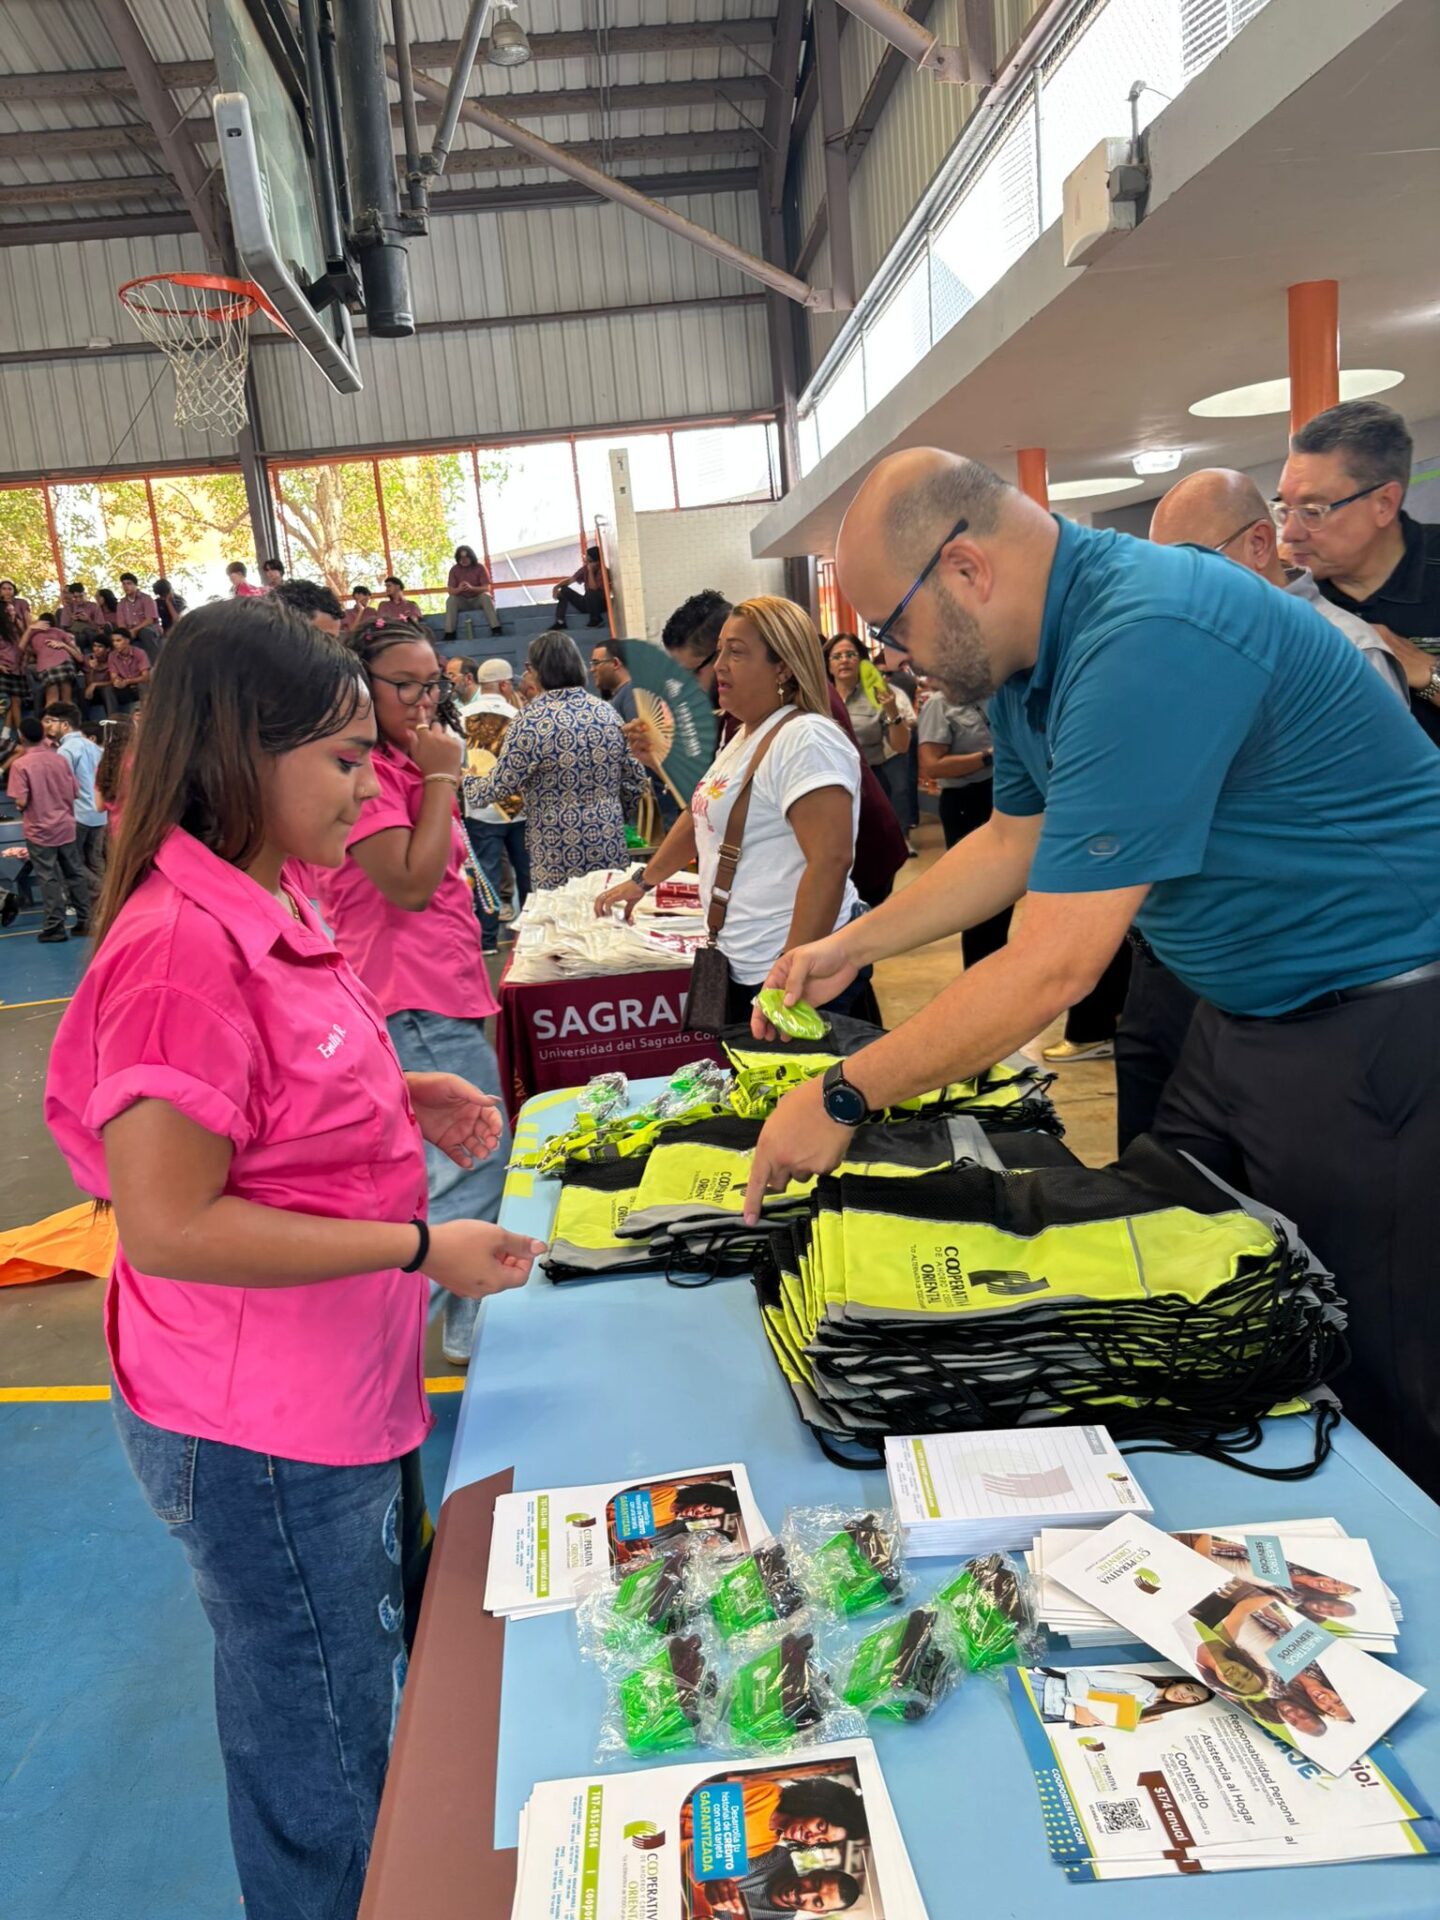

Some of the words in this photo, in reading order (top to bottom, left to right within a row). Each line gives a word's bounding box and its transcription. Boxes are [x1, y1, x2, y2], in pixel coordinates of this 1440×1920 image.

[533, 992, 688, 1039] SAGRA
[539, 1042, 613, 1060] Universidad
[617, 1038, 636, 1051] del
[639, 1033, 690, 1050] Sagrado
[1100, 1548, 1151, 1586] COOPERATIVA
[1277, 1629, 1314, 1661] SERVICIOS
[1200, 1733, 1232, 1781] Asistencia
[1225, 1713, 1276, 1786] Responsabilidad
[1268, 1785, 1299, 1827] Personal
[1173, 1751, 1212, 1810] Contenido
[1226, 1782, 1239, 1793] al
[720, 1792, 729, 1820] historial
[731, 1806, 740, 1842] Desarrolla
[1050, 1769, 1086, 1845] COOPORIENTAL.COM
[1154, 1787, 1170, 1808] $174
[1165, 1811, 1189, 1842] anual
[1231, 1794, 1256, 1826] Hogar
[699, 1792, 713, 1872] GARANTIZADA
[722, 1821, 730, 1831] de
[1284, 1834, 1297, 1846] al
[714, 1833, 723, 1858] tarjeta
